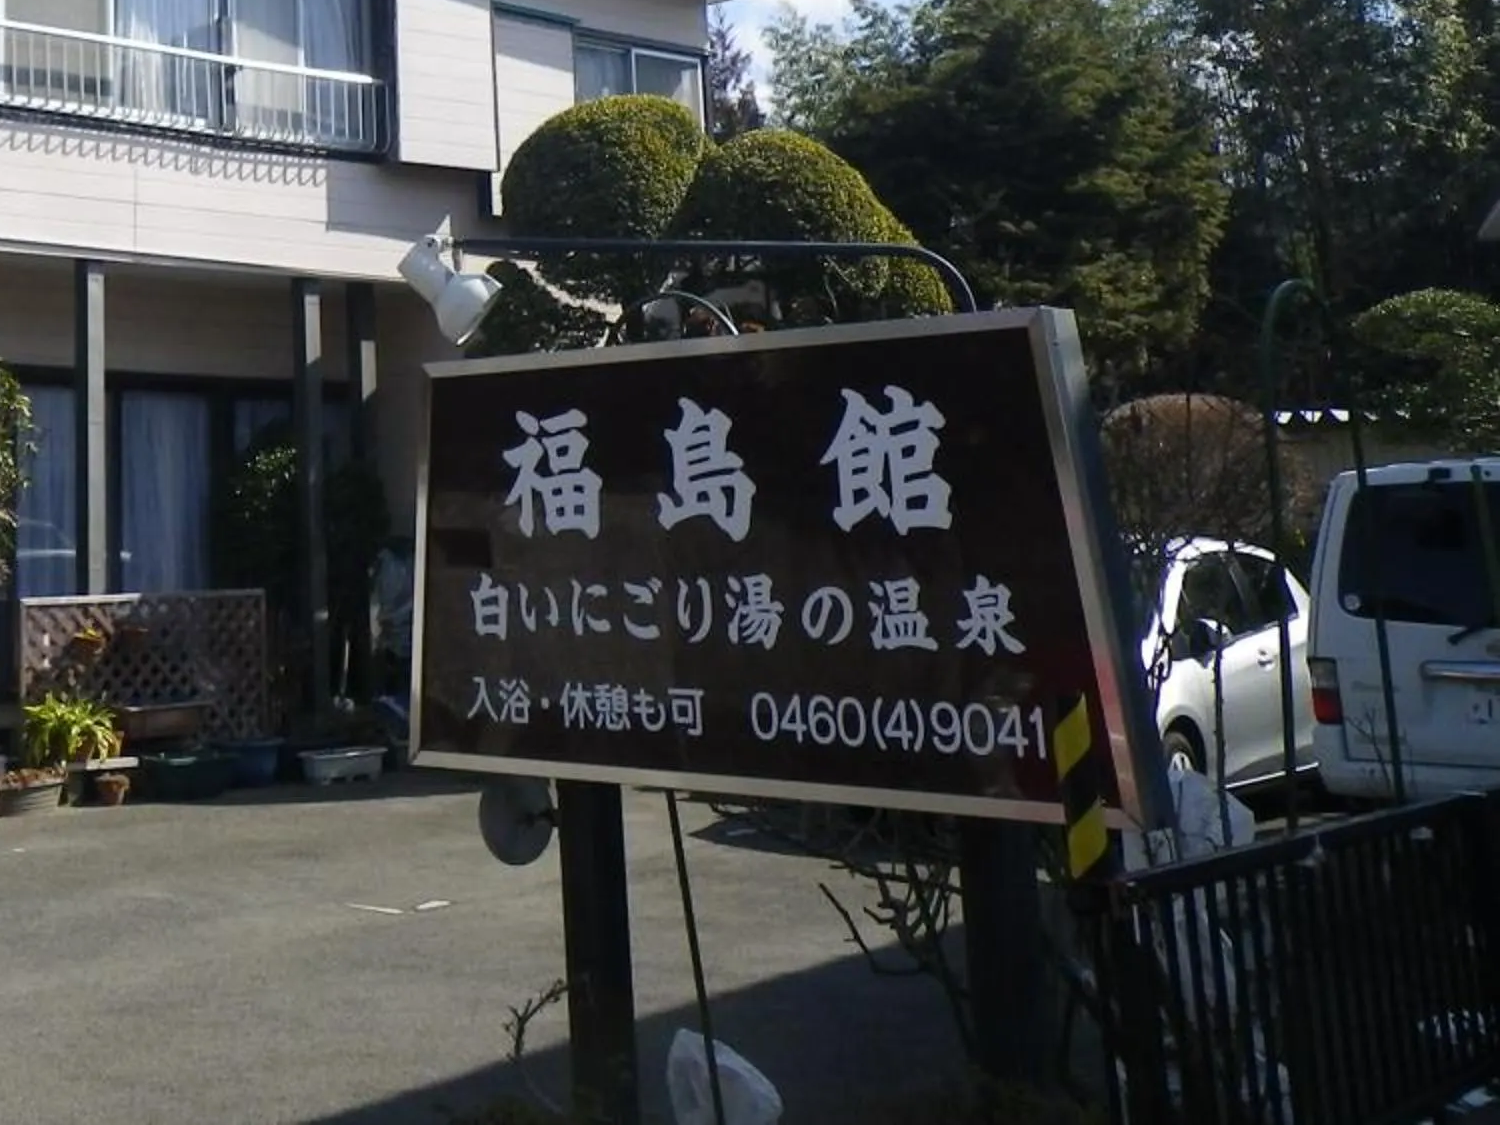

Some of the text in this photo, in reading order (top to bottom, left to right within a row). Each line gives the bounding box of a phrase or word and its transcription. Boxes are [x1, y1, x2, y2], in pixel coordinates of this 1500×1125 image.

[502, 385, 953, 542] 福島館
[470, 572, 1026, 656] 白いにごり湯の温泉
[467, 676, 1047, 759] 入浴・休憩も可 0460(4)9041
